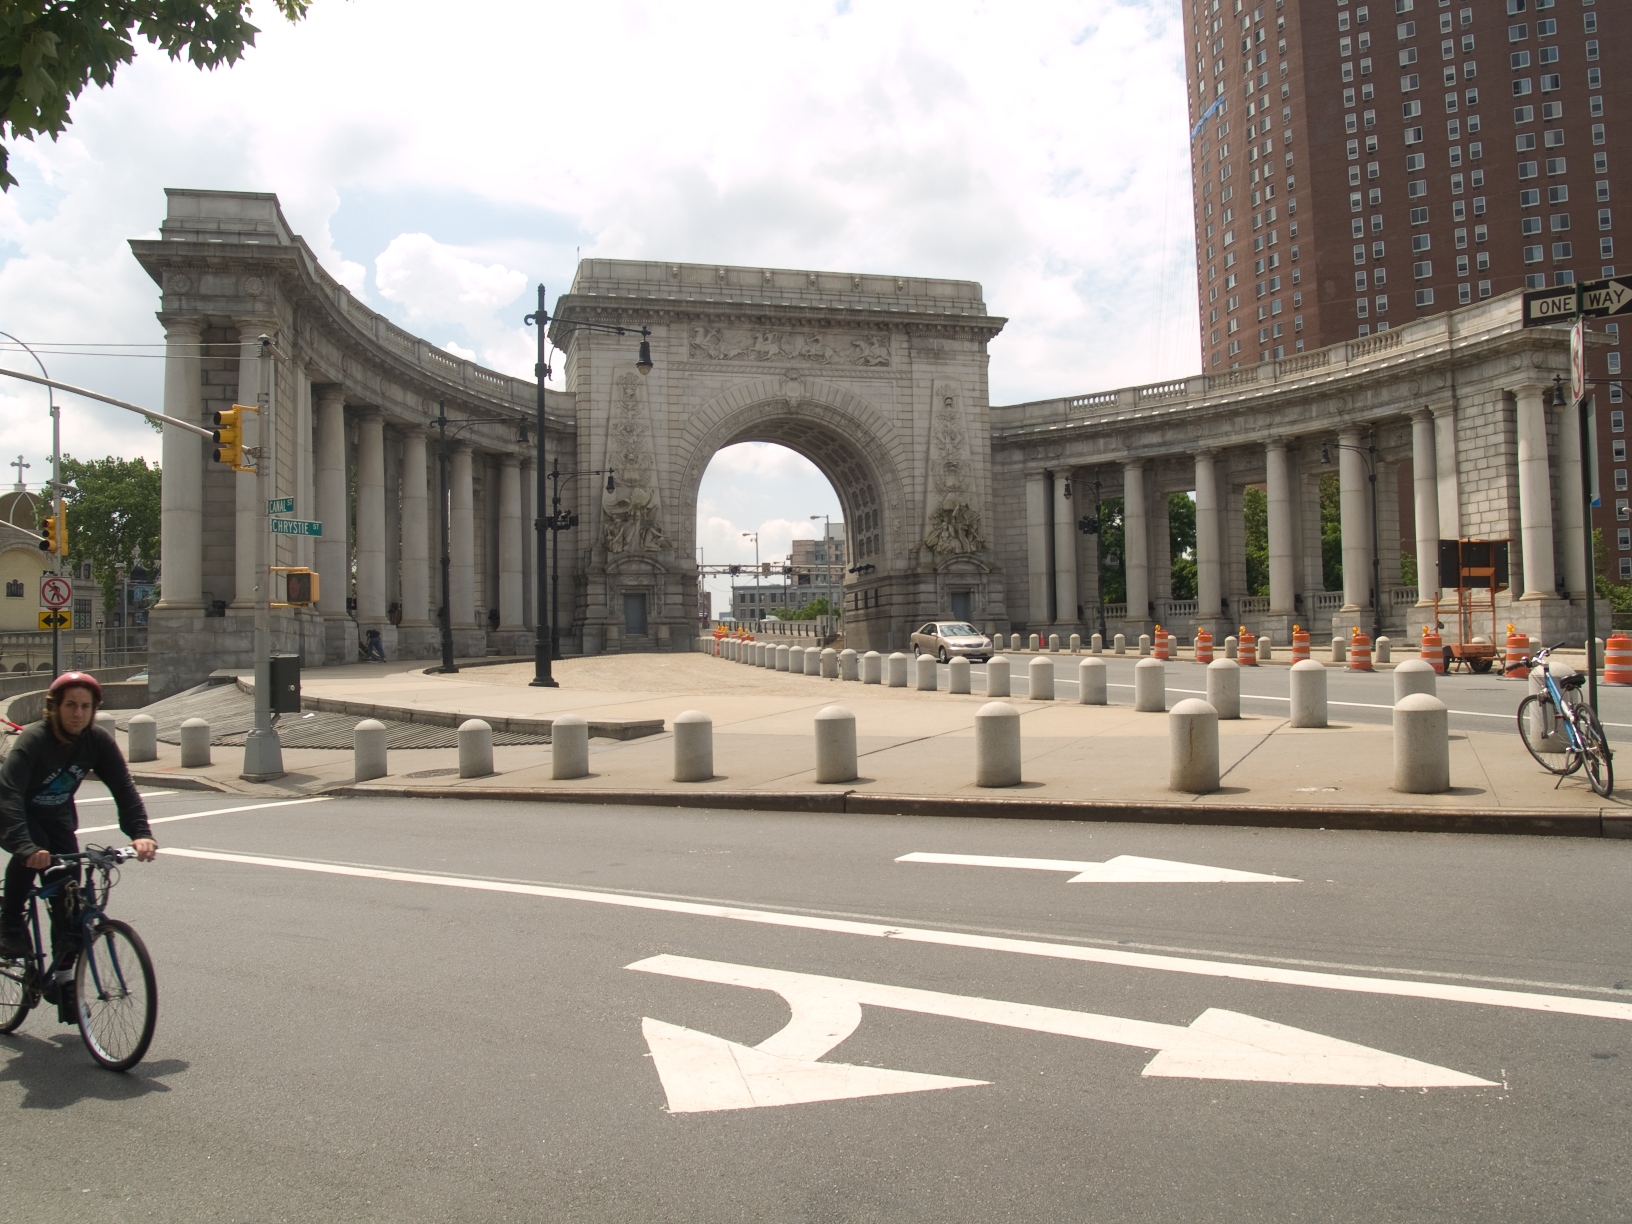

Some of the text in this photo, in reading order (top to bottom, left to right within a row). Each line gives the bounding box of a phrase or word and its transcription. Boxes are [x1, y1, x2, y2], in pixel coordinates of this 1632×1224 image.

[1539, 288, 1625, 315] ONE WAY
[269, 500, 287, 513] CANAL
[272, 520, 309, 534] CHRYSTIE
